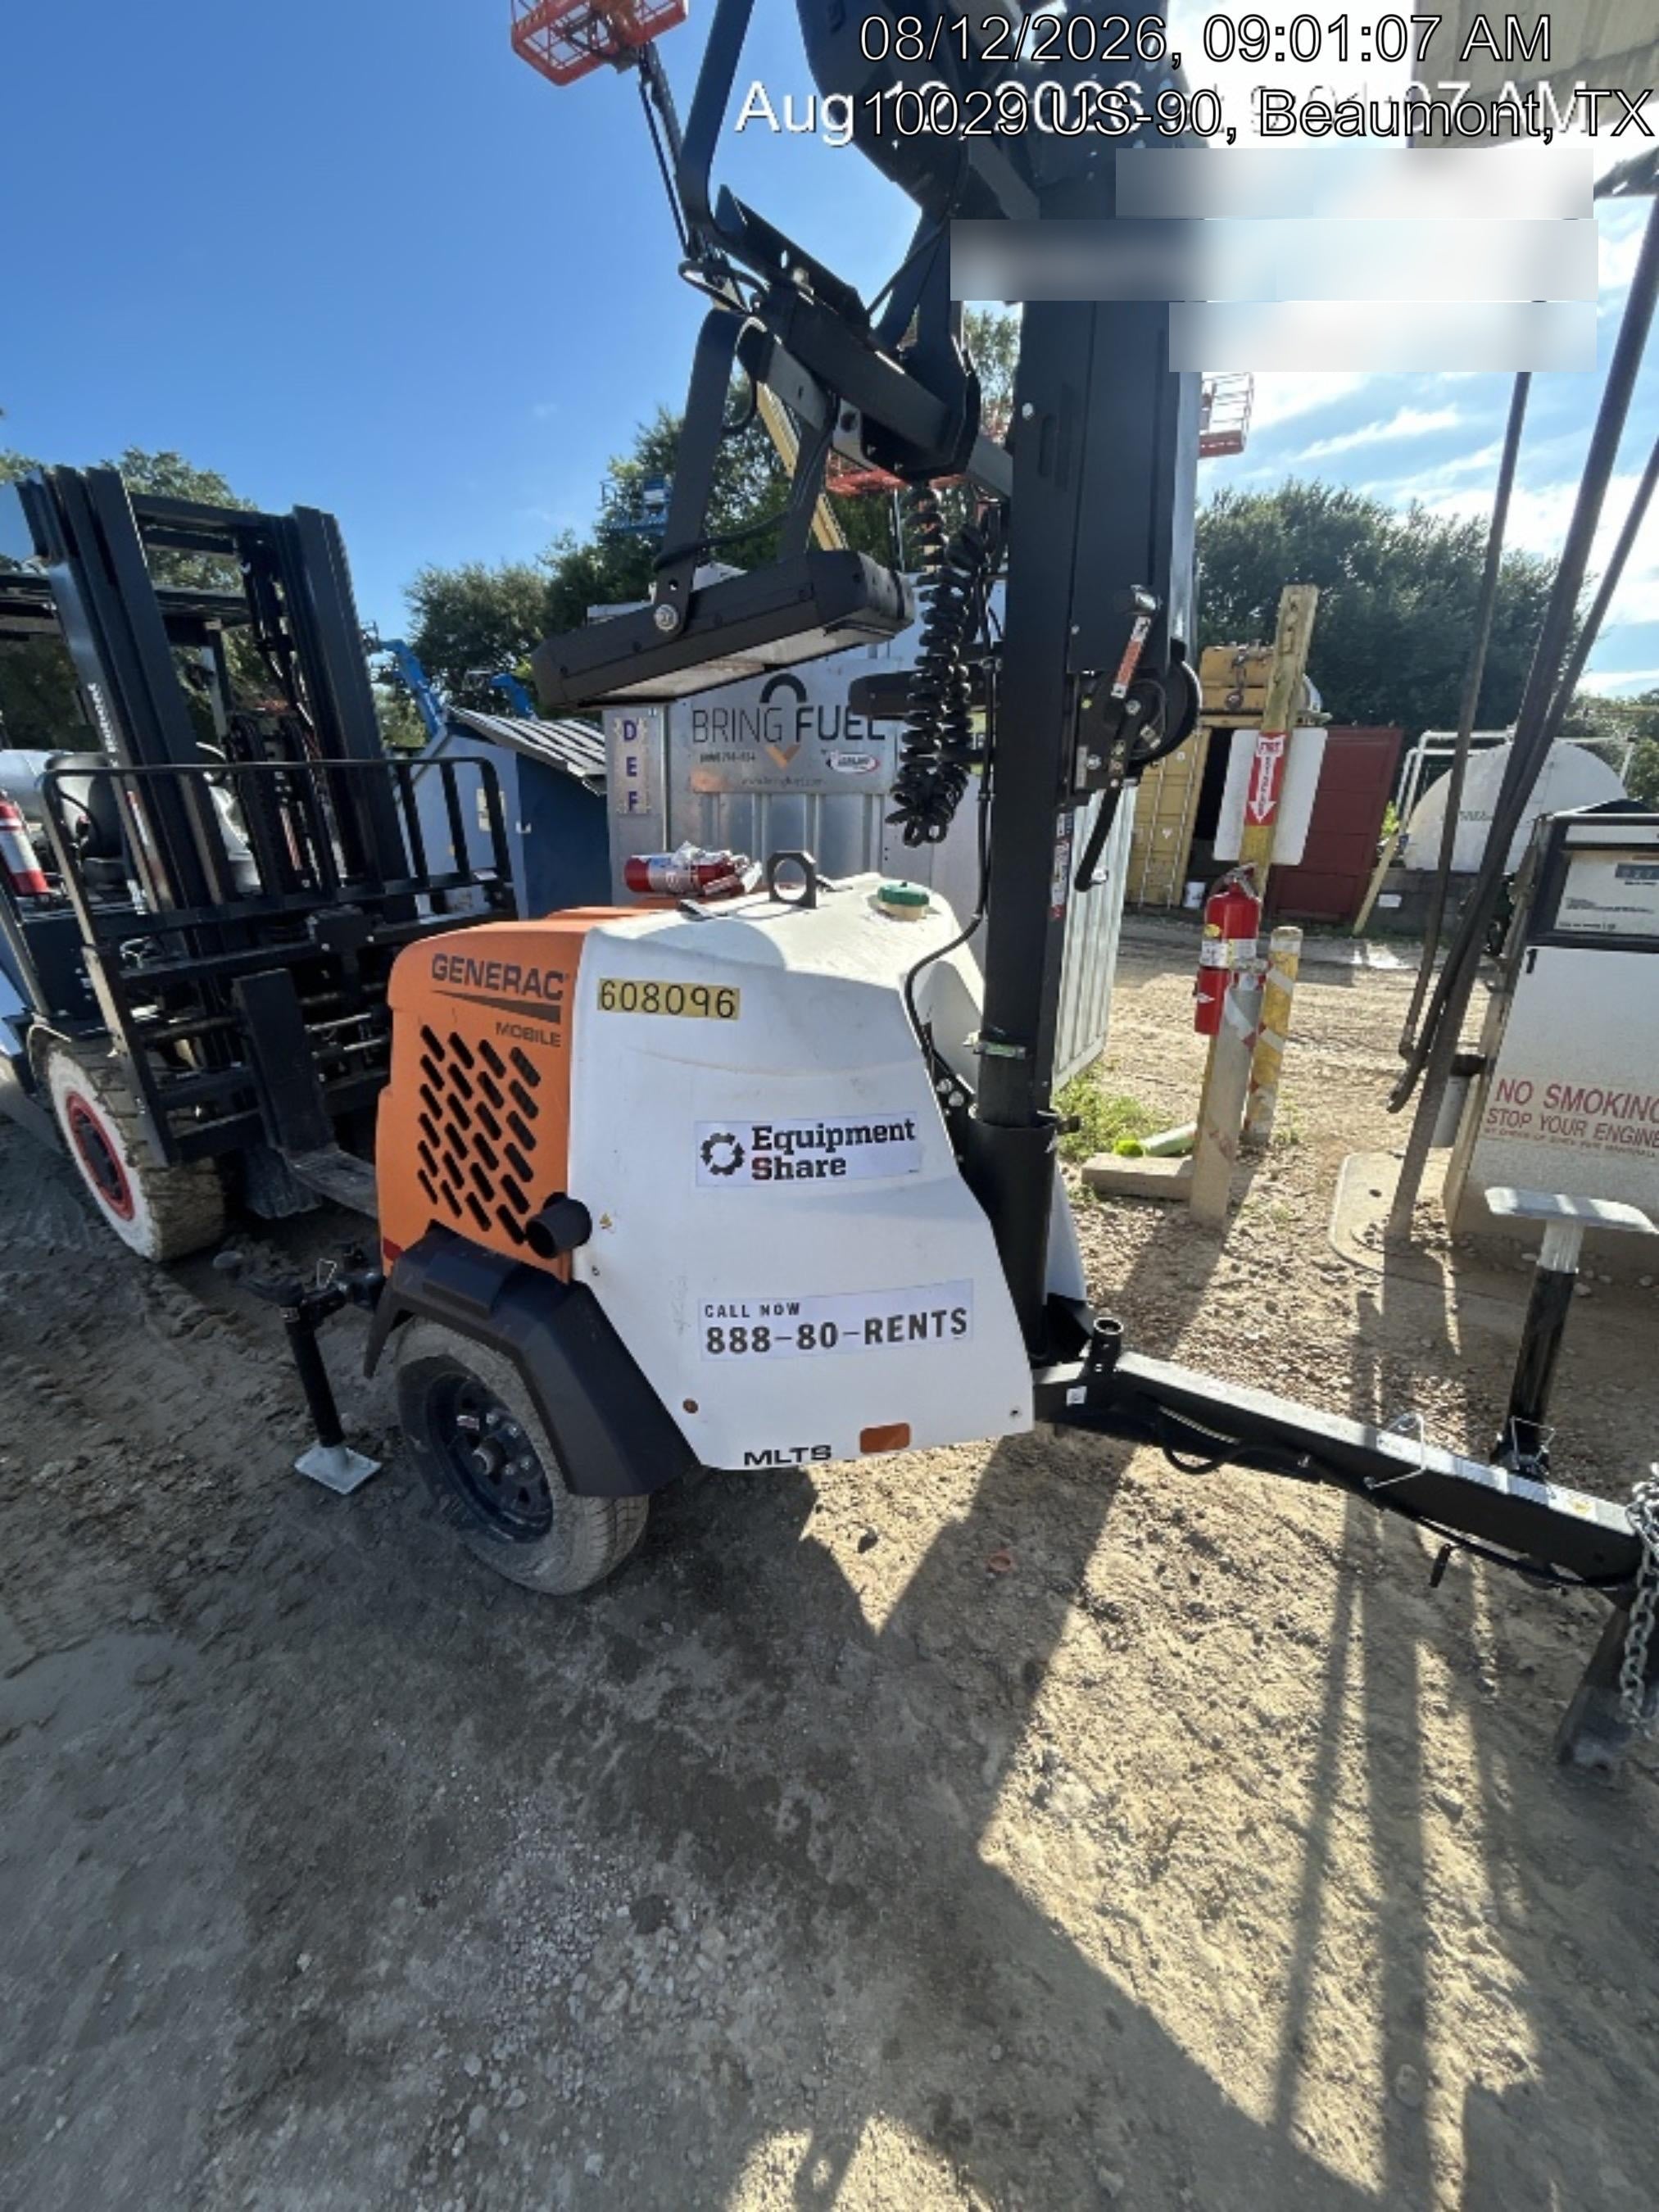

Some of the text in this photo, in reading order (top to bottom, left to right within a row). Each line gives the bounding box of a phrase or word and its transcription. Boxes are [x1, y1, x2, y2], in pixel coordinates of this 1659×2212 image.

[693, 705, 885, 743] BRING FUEL
[431, 953, 564, 1001] GENERAC
[601, 979, 737, 1018] 608096
[495, 1022, 562, 1048] MOBILE
[1494, 1078, 1534, 1105] NO
[751, 1118, 916, 1155] Equipment
[1487, 1108, 1532, 1128] STOP
[1540, 1113, 1588, 1137] YOUR
[751, 1156, 846, 1181] Share
[705, 1301, 800, 1318] CALL NOW
[706, 1307, 968, 1354] 888-80-RENTS
